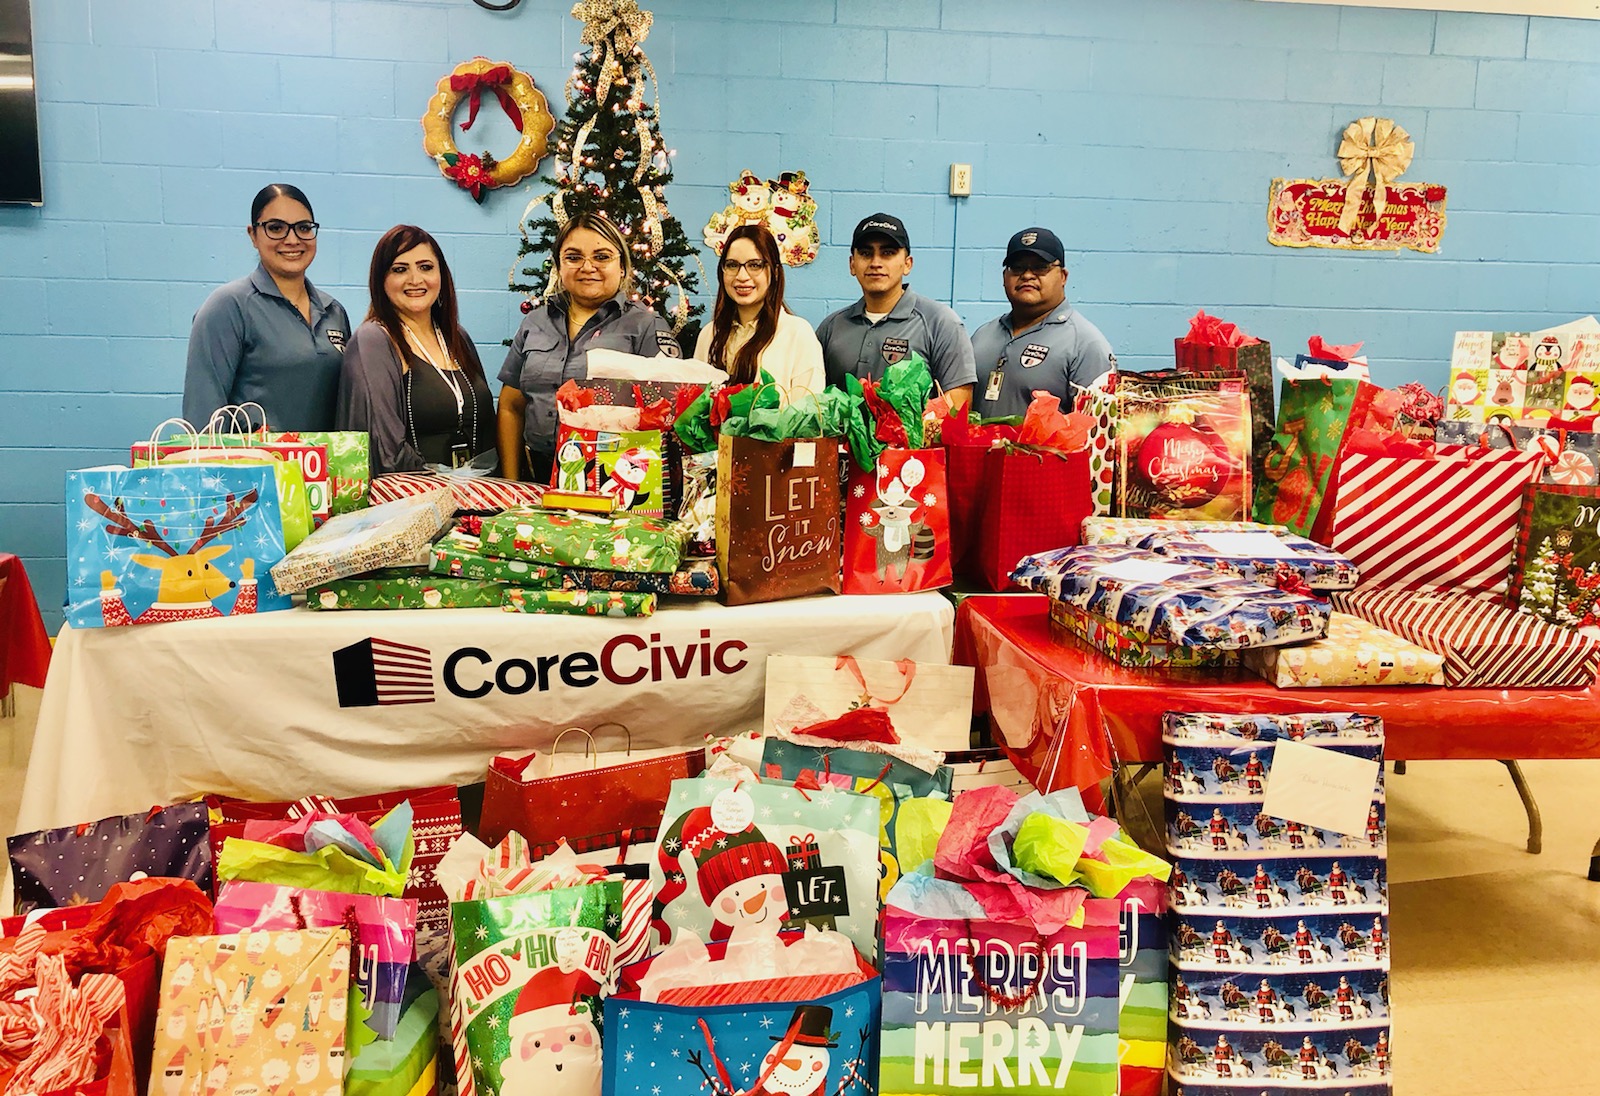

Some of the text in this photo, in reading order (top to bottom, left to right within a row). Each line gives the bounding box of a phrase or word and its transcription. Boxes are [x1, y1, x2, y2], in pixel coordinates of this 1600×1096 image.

[1306, 212, 1339, 229] Happ
[1380, 217, 1410, 231] Year
[1309, 198, 1344, 215] Merr
[1148, 456, 1221, 482] Christmas
[1163, 437, 1206, 464] Merry
[765, 475, 820, 521] LET
[762, 516, 836, 572] Snow
[795, 519, 811, 536] IT
[443, 629, 749, 699] CoreCivic
[797, 876, 836, 905] LET
[463, 953, 511, 1001] HO
[584, 935, 611, 976] HO
[914, 938, 1088, 1017] MERRY
[913, 1017, 1085, 1089] MERRY
